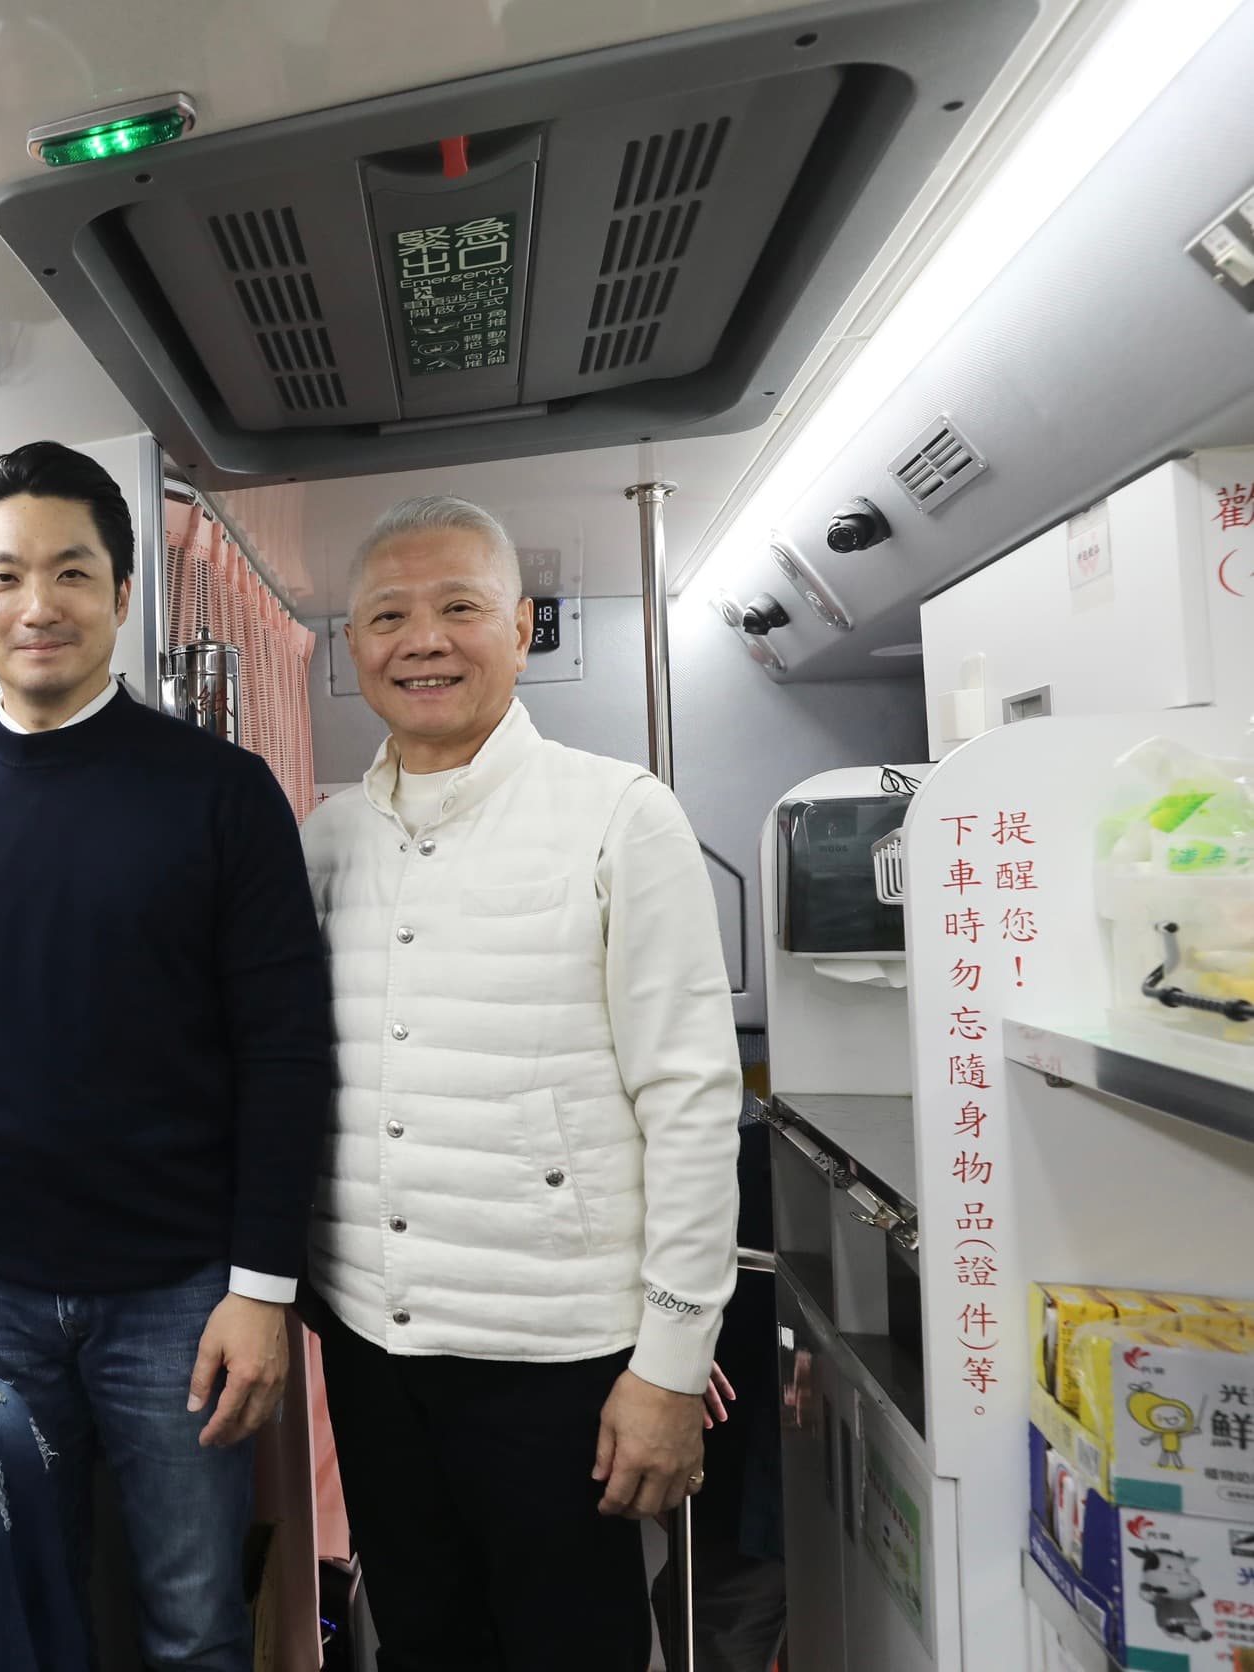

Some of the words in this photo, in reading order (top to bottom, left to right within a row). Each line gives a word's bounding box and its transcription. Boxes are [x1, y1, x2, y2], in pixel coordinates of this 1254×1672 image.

[397, 217, 510, 256] 緊急
[400, 264, 513, 288] Emergency
[402, 241, 508, 278] 出口
[462, 277, 505, 291] Exit
[991, 811, 1039, 987] 提醒您！
[644, 1283, 703, 1315] albon
